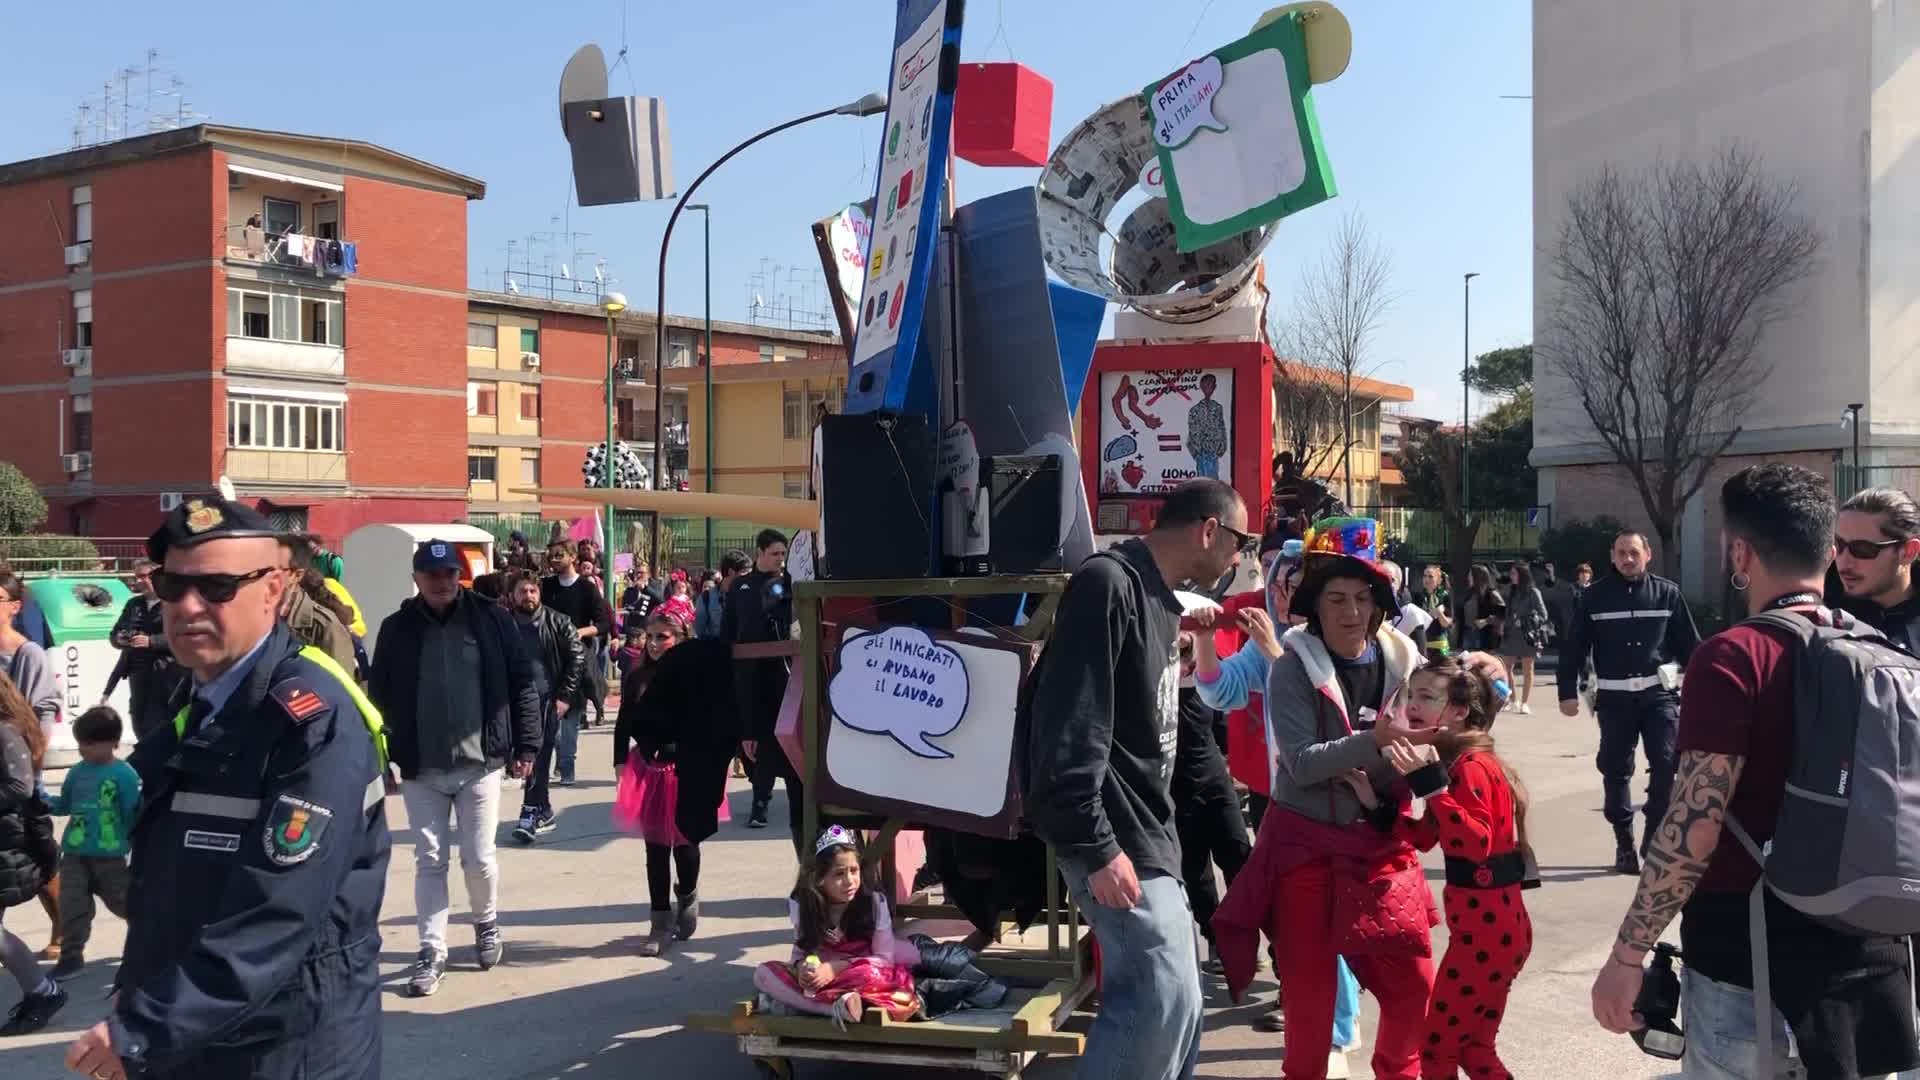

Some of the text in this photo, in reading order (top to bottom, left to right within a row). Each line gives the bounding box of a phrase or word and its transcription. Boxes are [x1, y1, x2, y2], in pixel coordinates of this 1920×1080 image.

[1158, 72, 1196, 111] PRIMA
[1161, 81, 1213, 143] gli ITALIANI
[1161, 468, 1196, 479] UOMO
[864, 636, 955, 669] gli IMMIGRATI
[66, 646, 80, 725] VETRO
[883, 659, 936, 685] RUBANO
[875, 679, 944, 709] il LAVORO
